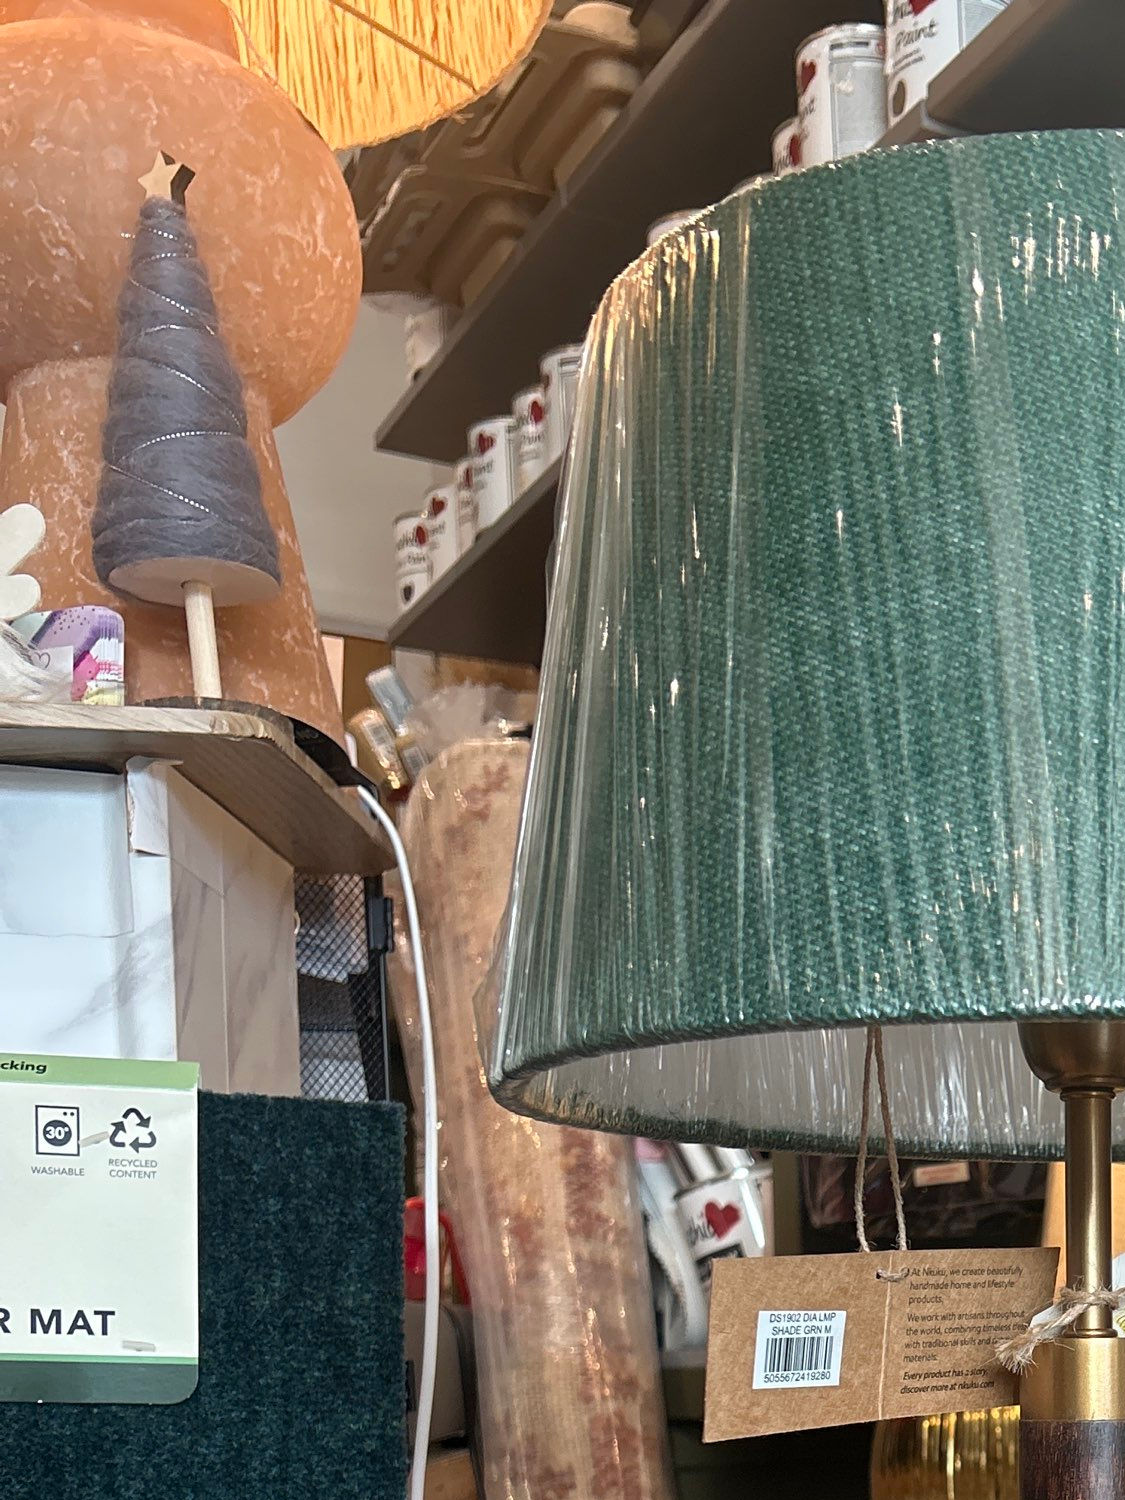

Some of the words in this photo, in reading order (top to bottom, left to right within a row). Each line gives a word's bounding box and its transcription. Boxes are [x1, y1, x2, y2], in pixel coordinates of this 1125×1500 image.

[109, 1158, 158, 1169] RECYCLED
[31, 1166, 85, 1177] WASHABLE
[110, 1169, 158, 1179] CONTENT
[911, 1267, 921, 1276] At
[962, 1268, 986, 1276] create
[909, 1281, 949, 1291] handmade
[950, 1281, 971, 1290] home
[973, 1280, 986, 1289] and
[987, 1279, 1015, 1290] lifestyle
[769, 1313, 802, 1323] DS1902
[803, 1313, 818, 1322] DIA
[819, 1312, 837, 1322] LMP
[907, 1313, 919, 1322] We
[920, 1313, 940, 1322] work
[941, 1312, 957, 1322] with
[957, 1311, 985, 1321] artisans
[986, 1309, 1026, 1322] throughout
[30, 1308, 116, 1337] MAT
[772, 1326, 801, 1335] SHADE
[803, 1325, 822, 1334] GRN
[824, 1325, 832, 1334] M
[906, 1326, 919, 1335] the
[944, 1325, 981, 1336] combining
[982, 1323, 1011, 1333] timeless
[904, 1340, 921, 1350] with
[922, 1338, 959, 1349] traditional
[959, 1337, 977, 1348] skills
[977, 1337, 991, 1346] and
[764, 1371, 831, 1383] 5055672419280
[902, 1371, 923, 1381] Every
[923, 1369, 952, 1381] product
[952, 1368, 964, 1378] has
[900, 1384, 930, 1395] discover
[930, 1383, 949, 1392] more
[949, 1382, 958, 1390] at
